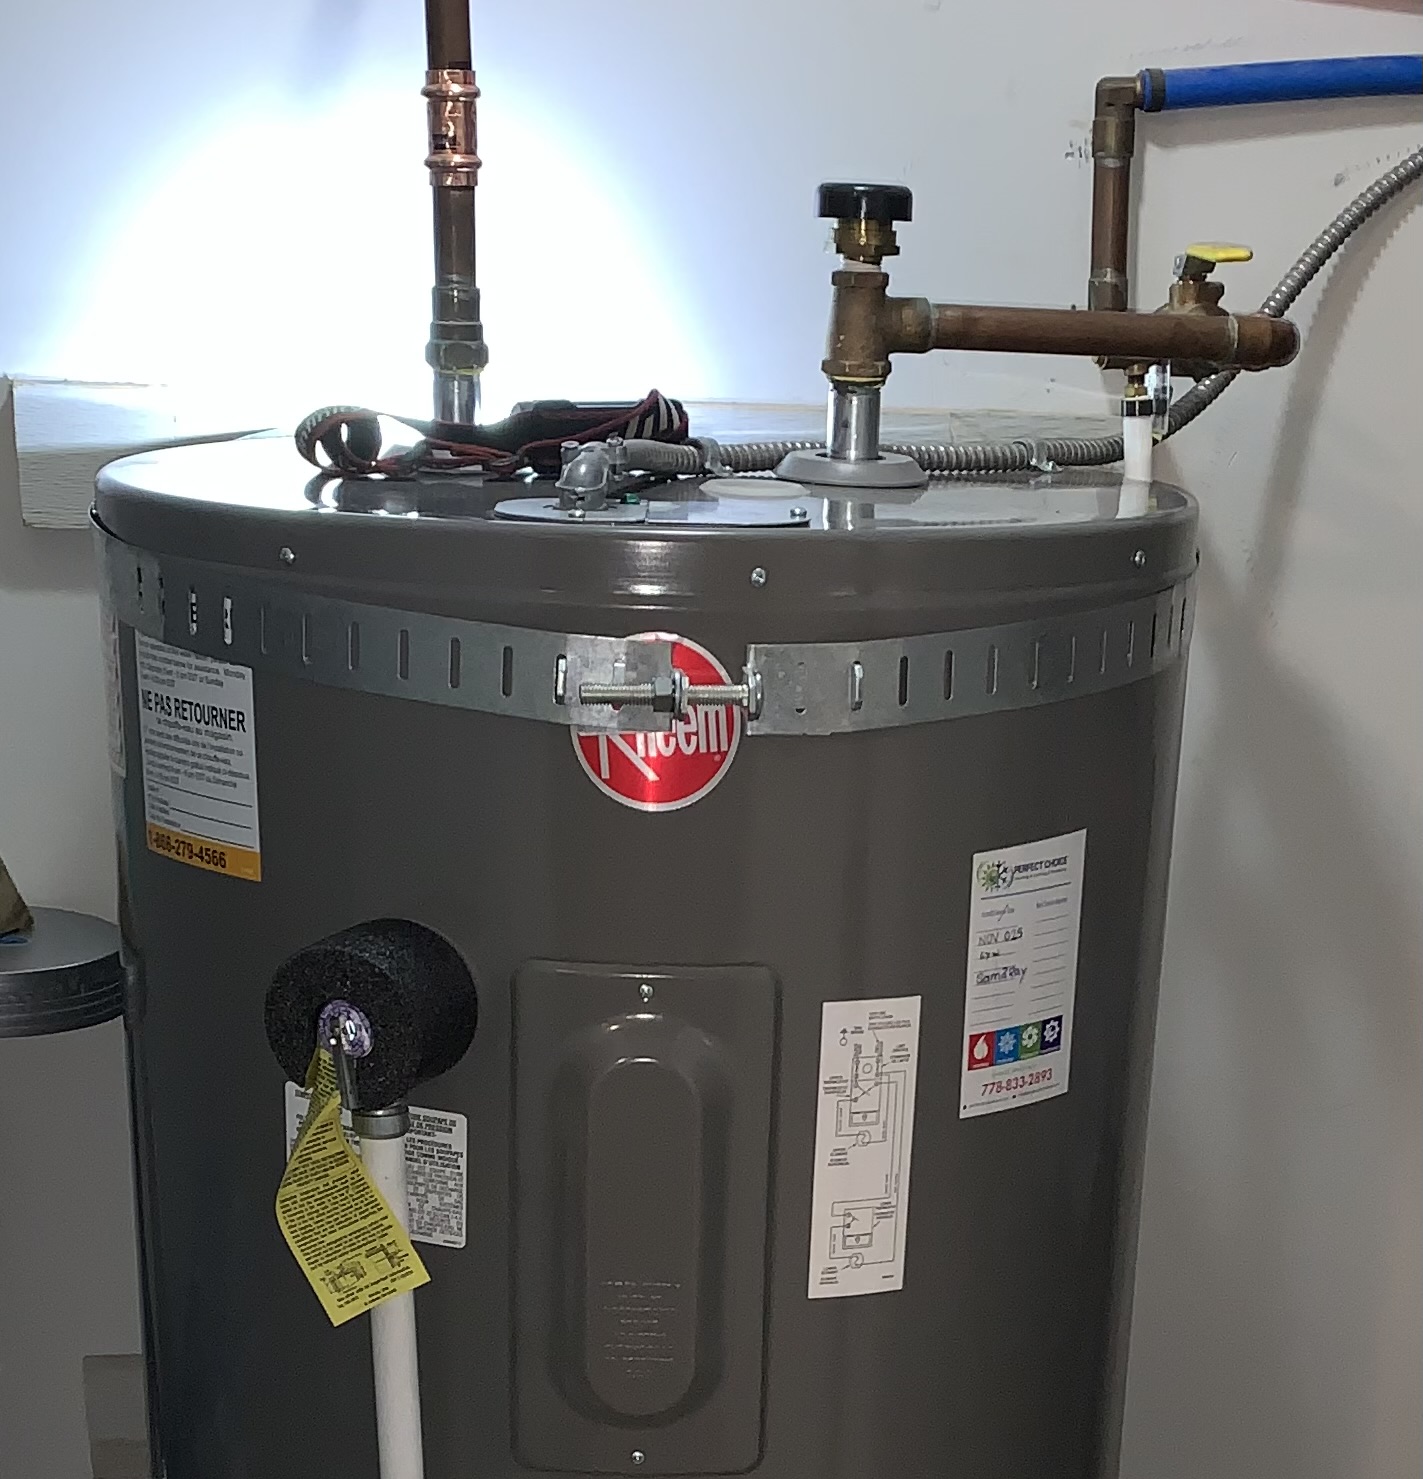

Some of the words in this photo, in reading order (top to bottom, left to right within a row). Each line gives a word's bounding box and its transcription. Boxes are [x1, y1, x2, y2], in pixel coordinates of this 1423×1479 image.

[141, 689, 152, 711] NE
[154, 693, 172, 716] PAS
[174, 698, 246, 733] RETOURNER
[982, 1068, 1052, 1096] 778-833-2893
